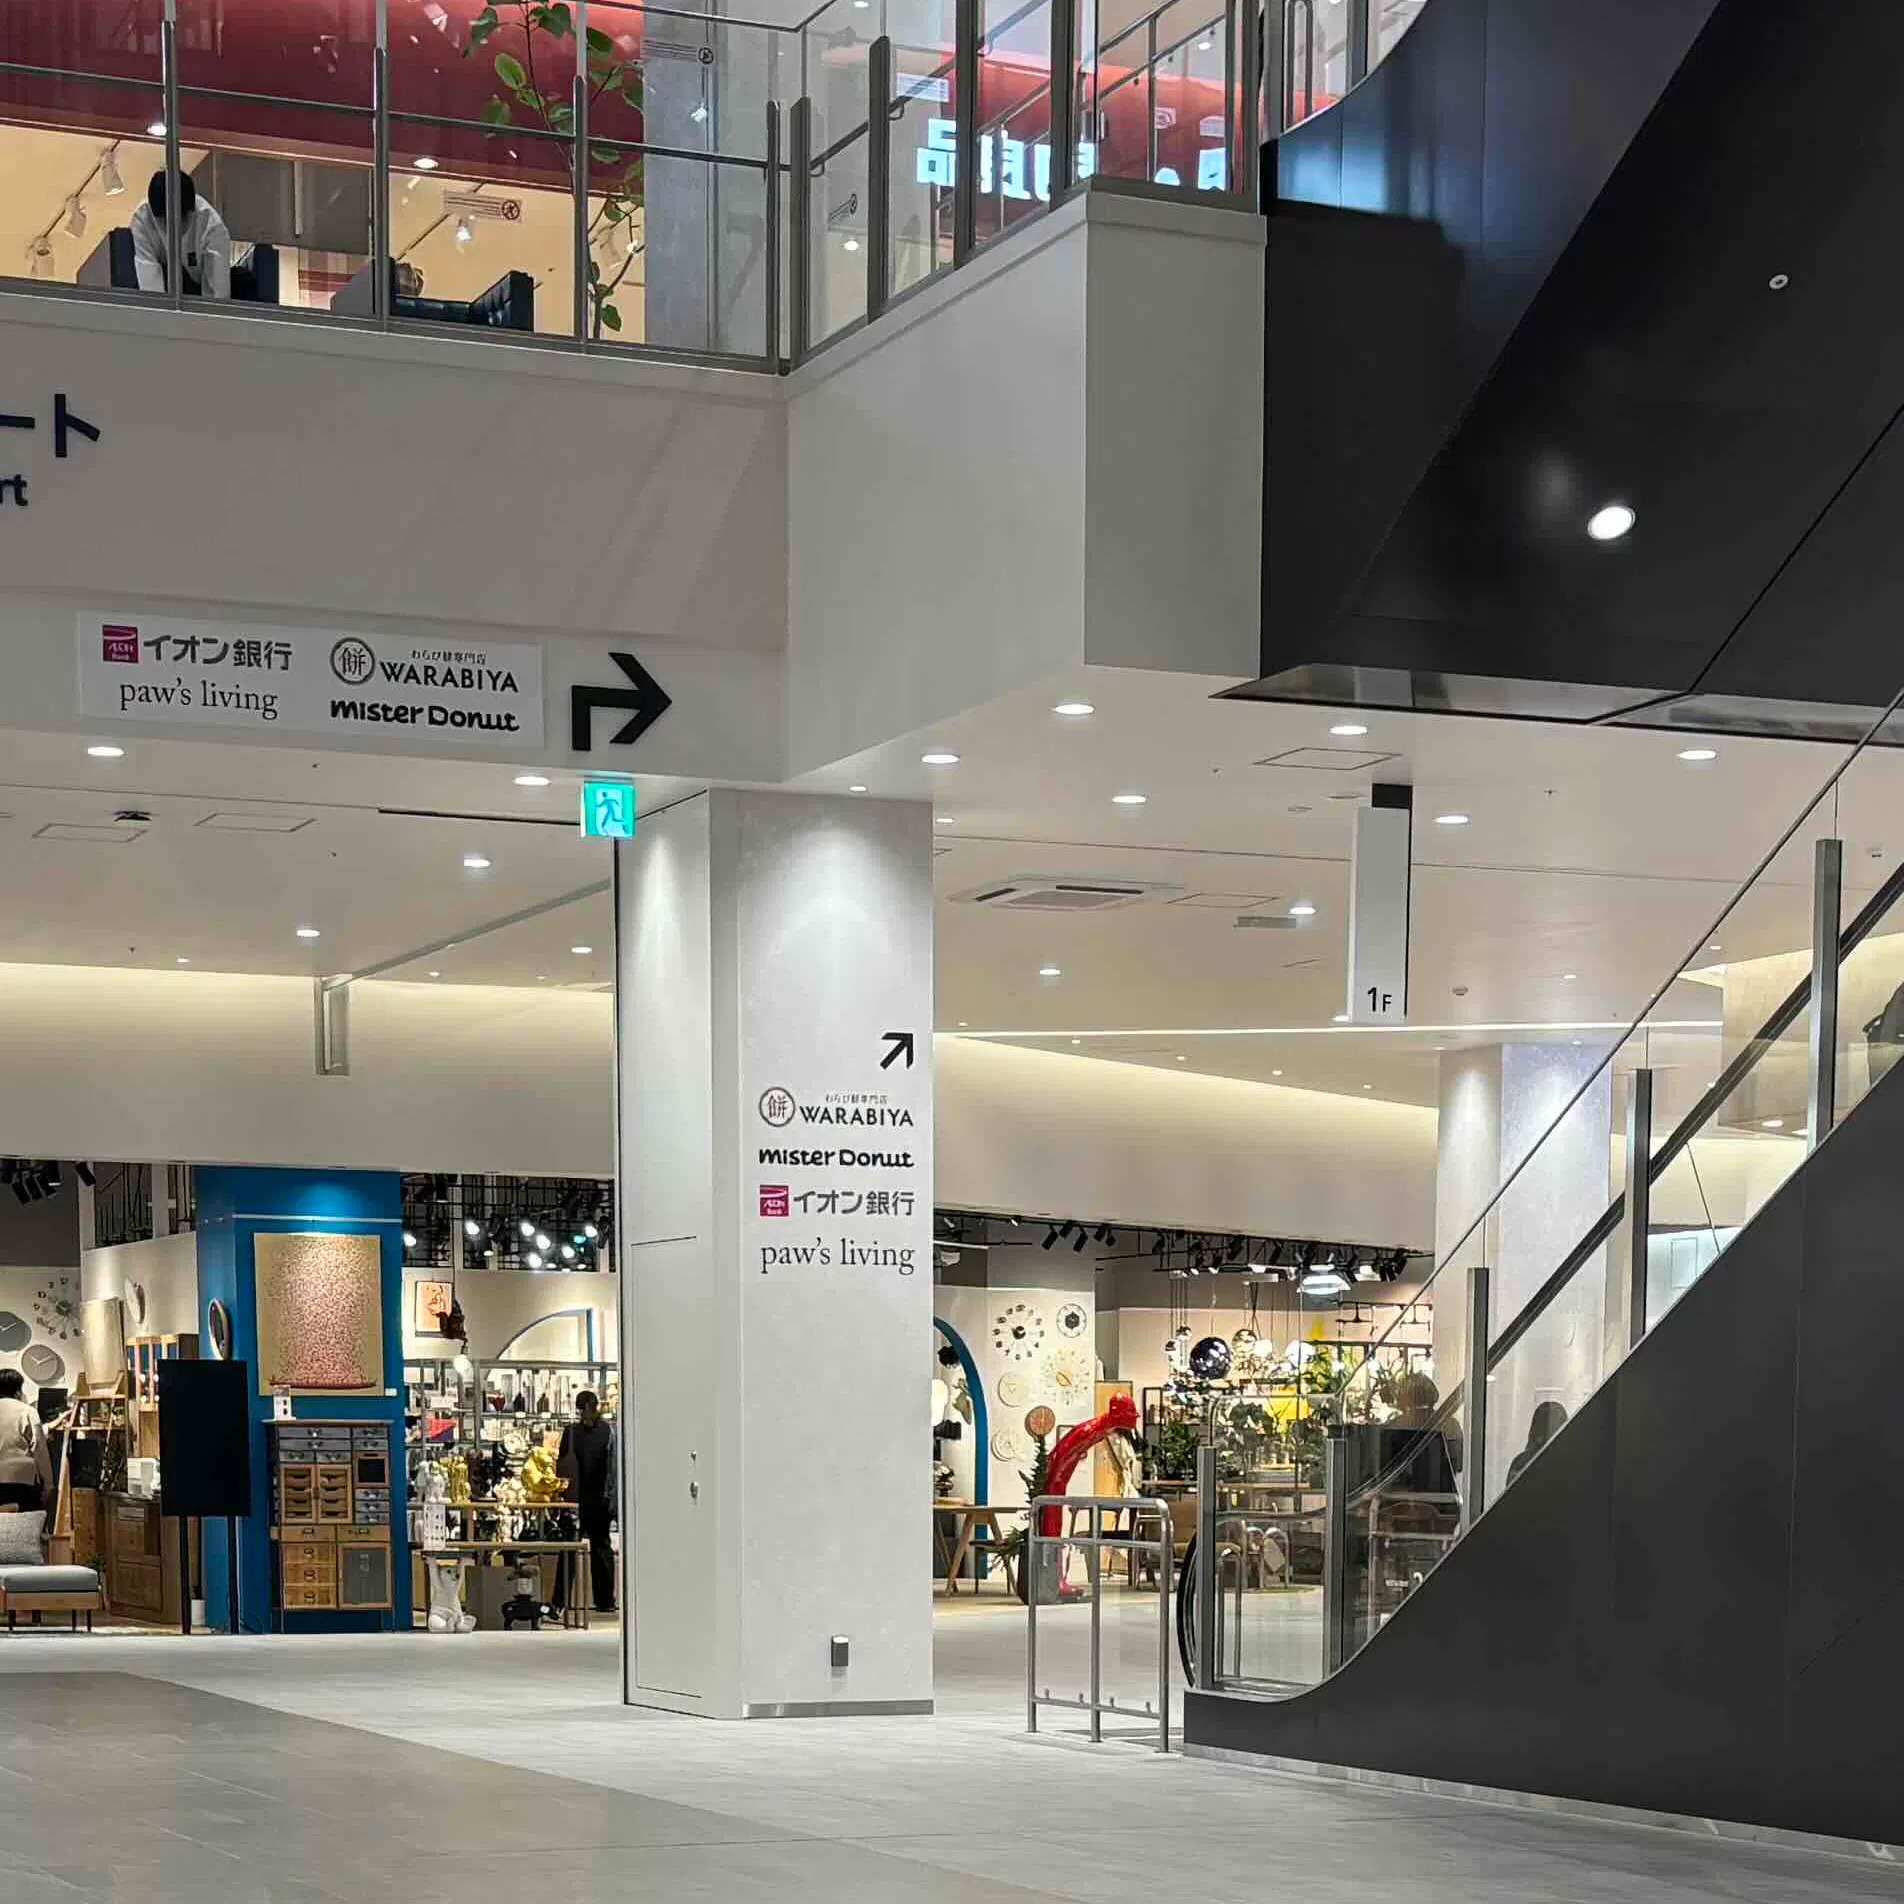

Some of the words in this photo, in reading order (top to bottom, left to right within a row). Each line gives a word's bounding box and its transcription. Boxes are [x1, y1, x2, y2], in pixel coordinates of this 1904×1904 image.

[143, 634, 293, 671] イオン銀行
[380, 661, 519, 693] WARABIYA
[119, 677, 193, 711] paw's
[201, 680, 279, 721] living
[428, 704, 521, 731] Donut
[1367, 986, 1392, 1012] 1F
[799, 1105, 914, 1127] WARABIYA
[839, 1149, 914, 1168] Donut
[794, 1189, 915, 1216] イオン銀行
[761, 1236, 831, 1275] paw's
[840, 1237, 916, 1276] living
